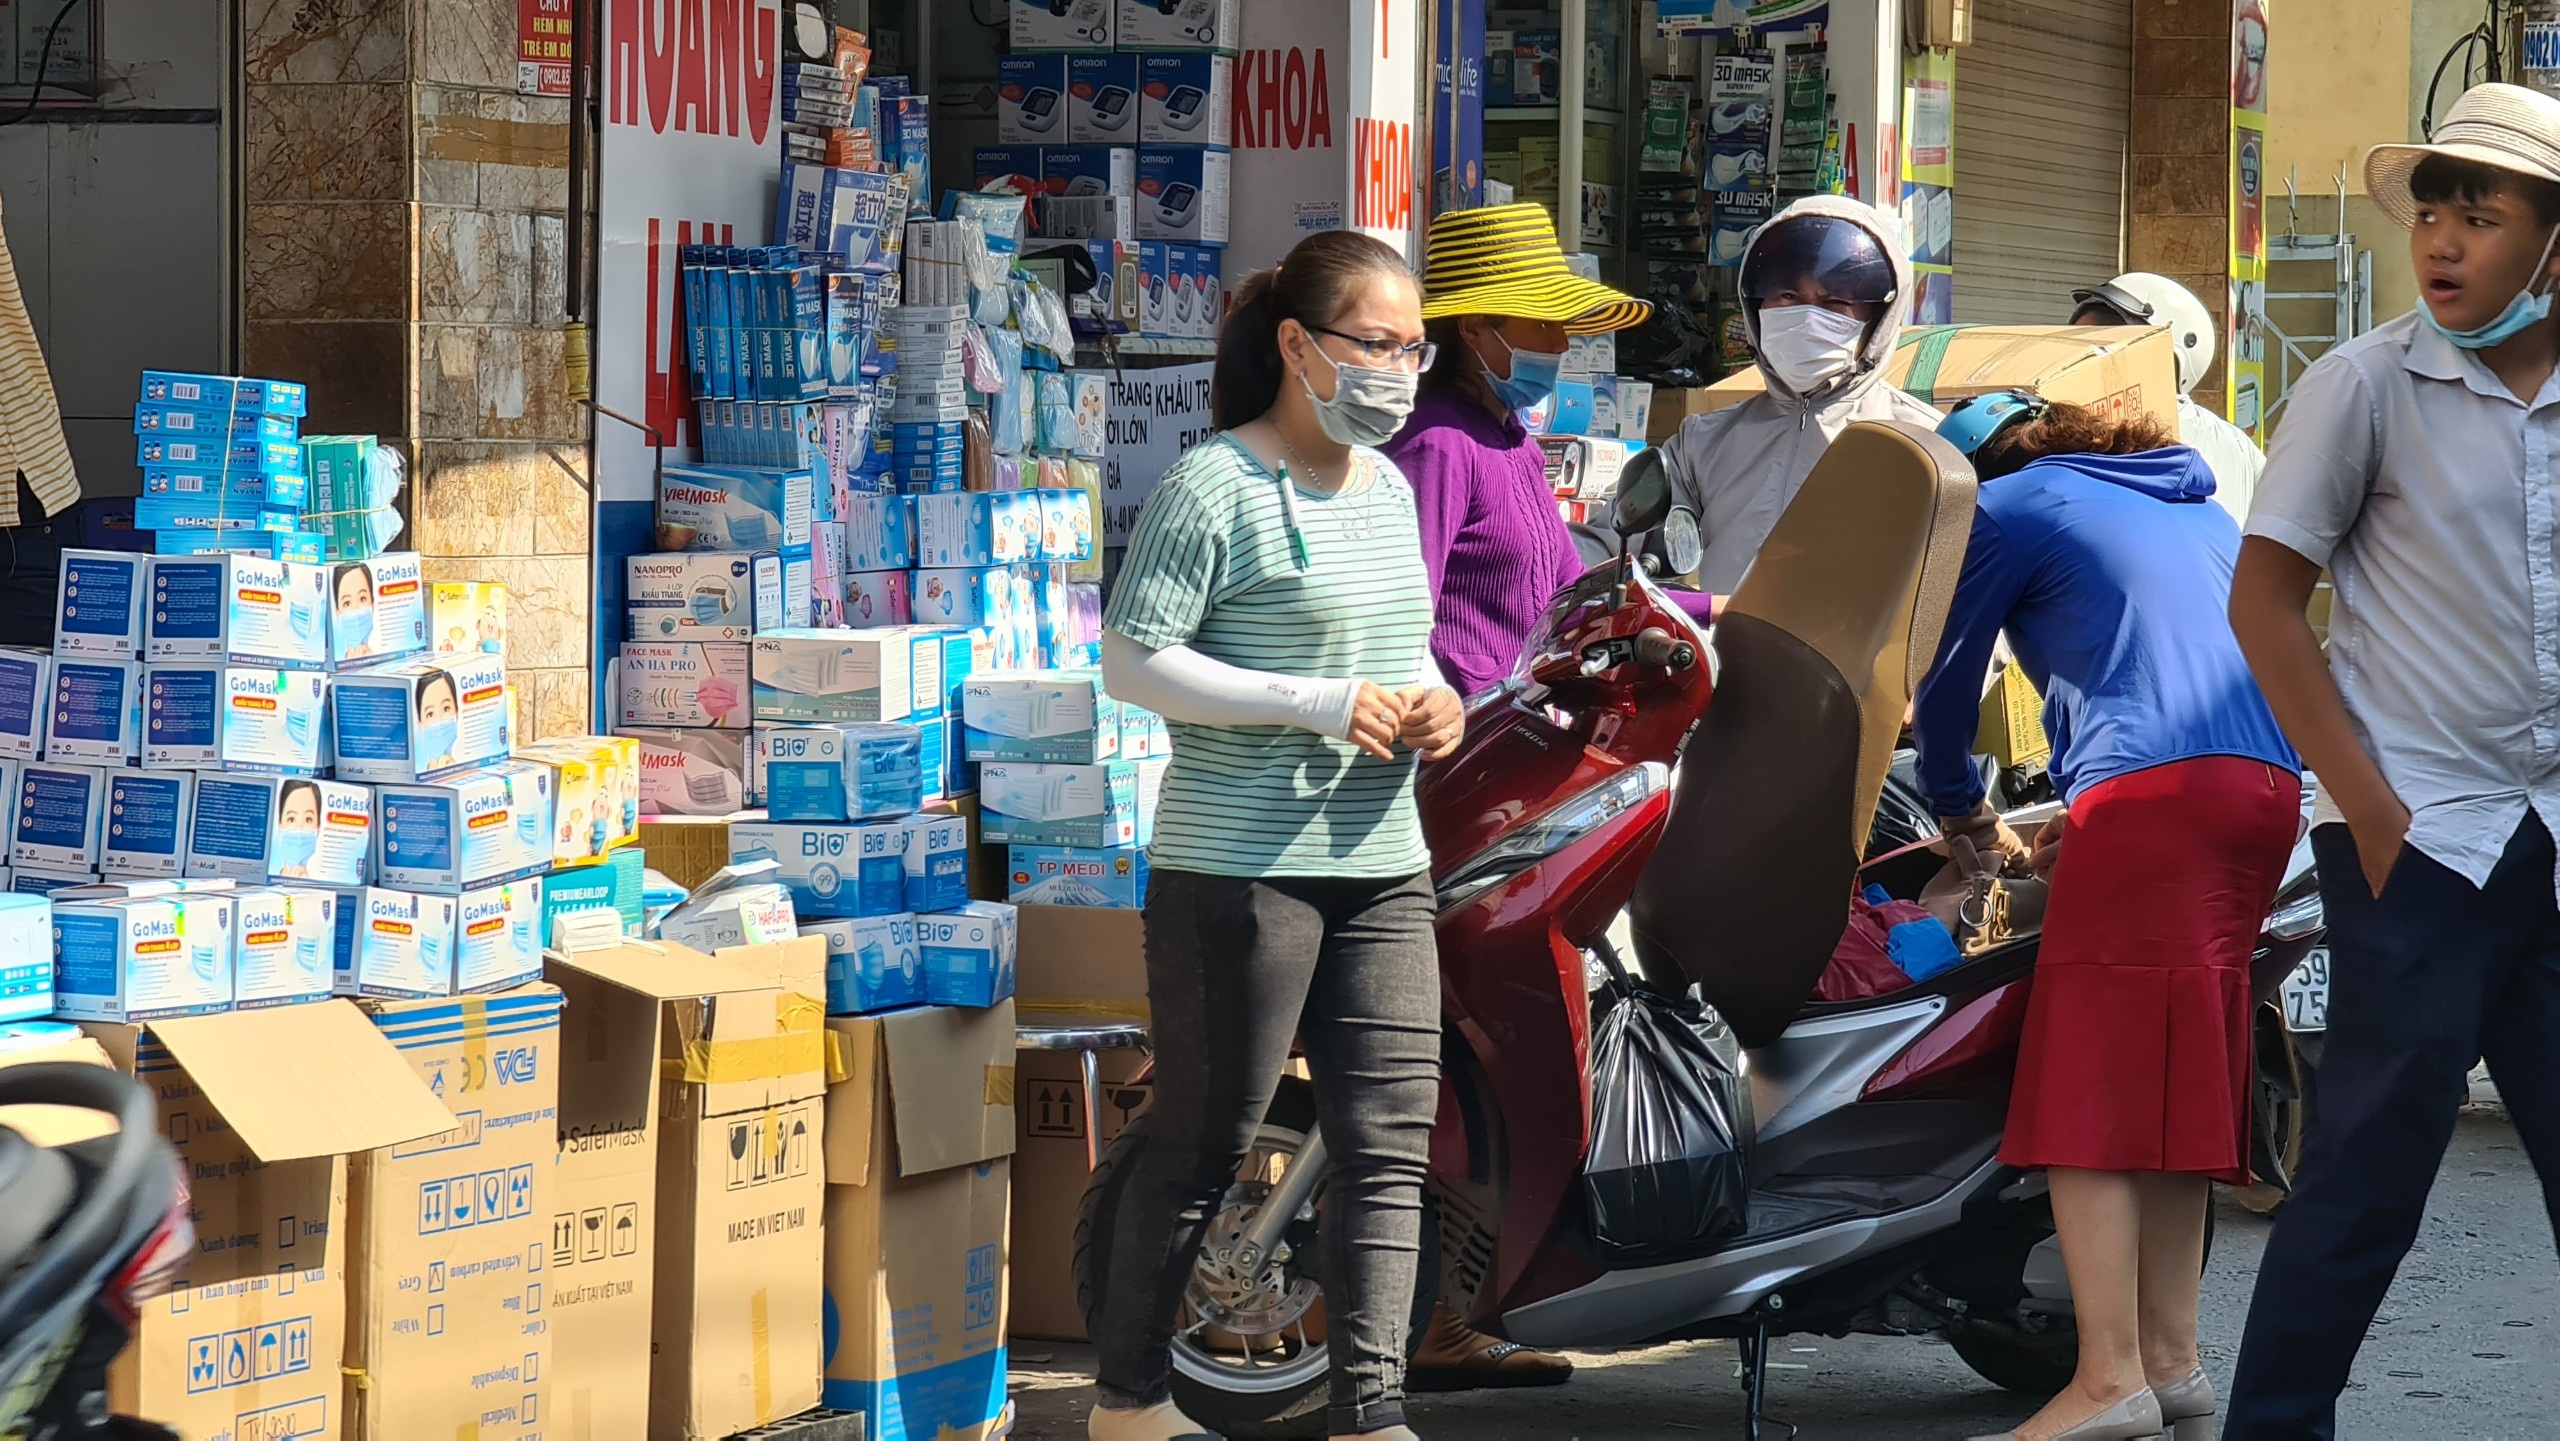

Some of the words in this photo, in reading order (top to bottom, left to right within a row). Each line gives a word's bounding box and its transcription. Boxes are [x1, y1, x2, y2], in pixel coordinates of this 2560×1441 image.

[556, 18, 572, 35] NH
[2524, 31, 2560, 68] 0902.0
[1001, 61, 1035, 70] OMRON
[1073, 59, 1107, 67] OMRON
[1147, 58, 1181, 67] OMRON
[1713, 65, 1731, 81] 3D
[1734, 67, 1771, 83] MASK
[1231, 46, 1333, 151] KHOA
[976, 153, 1010, 161] OMRON
[1047, 155, 1080, 163] OMRON
[1141, 155, 1173, 164] OMRON
[1354, 116, 1412, 232] KHOA
[1735, 191, 1772, 207] MASK
[1110, 381, 1152, 407] TRANG
[1155, 375, 1193, 417] KHẨU
[1123, 414, 1148, 444] LỚN
[1106, 455, 1122, 491] GIÁ
[1118, 506, 1127, 534] 40
[236, 569, 285, 589] GoMask
[377, 562, 419, 582] GoMask
[634, 565, 683, 578] NANOPRO
[661, 591, 684, 599] TRANG
[626, 648, 648, 656] FACE
[649, 648, 673, 656] MASK
[626, 659, 645, 670] AN
[648, 660, 666, 671] HA
[670, 660, 697, 671] PRO
[230, 676, 280, 695] GoMask
[460, 668, 503, 690] GoMask
[641, 751, 687, 770] tMask
[327, 793, 370, 812] GoMask
[1036, 861, 1058, 875] TP
[1063, 862, 1106, 876] MEDI
[371, 900, 410, 919] GoMas
[464, 898, 506, 920] GoMask
[132, 920, 176, 937] GoMas
[243, 909, 285, 929] GoMas
[493, 1046, 537, 1085] FDA
[569, 1119, 646, 1154] SaferMask
[727, 1220, 756, 1244] MADE
[757, 1217, 766, 1238] IN
[767, 1212, 785, 1236] VIET
[787, 1207, 806, 1231] NAM
[450, 1260, 481, 1279] carbon
[482, 1254, 524, 1275] Activated
[502, 1295, 521, 1311] Blue
[552, 1291, 563, 1308] ẢN
[563, 1286, 586, 1306] XUẤT
[600, 1281, 615, 1303] VIỆT
[615, 1280, 634, 1297] NAM
[470, 1366, 520, 1389] Disposable
[481, 1405, 518, 1428] Medical
